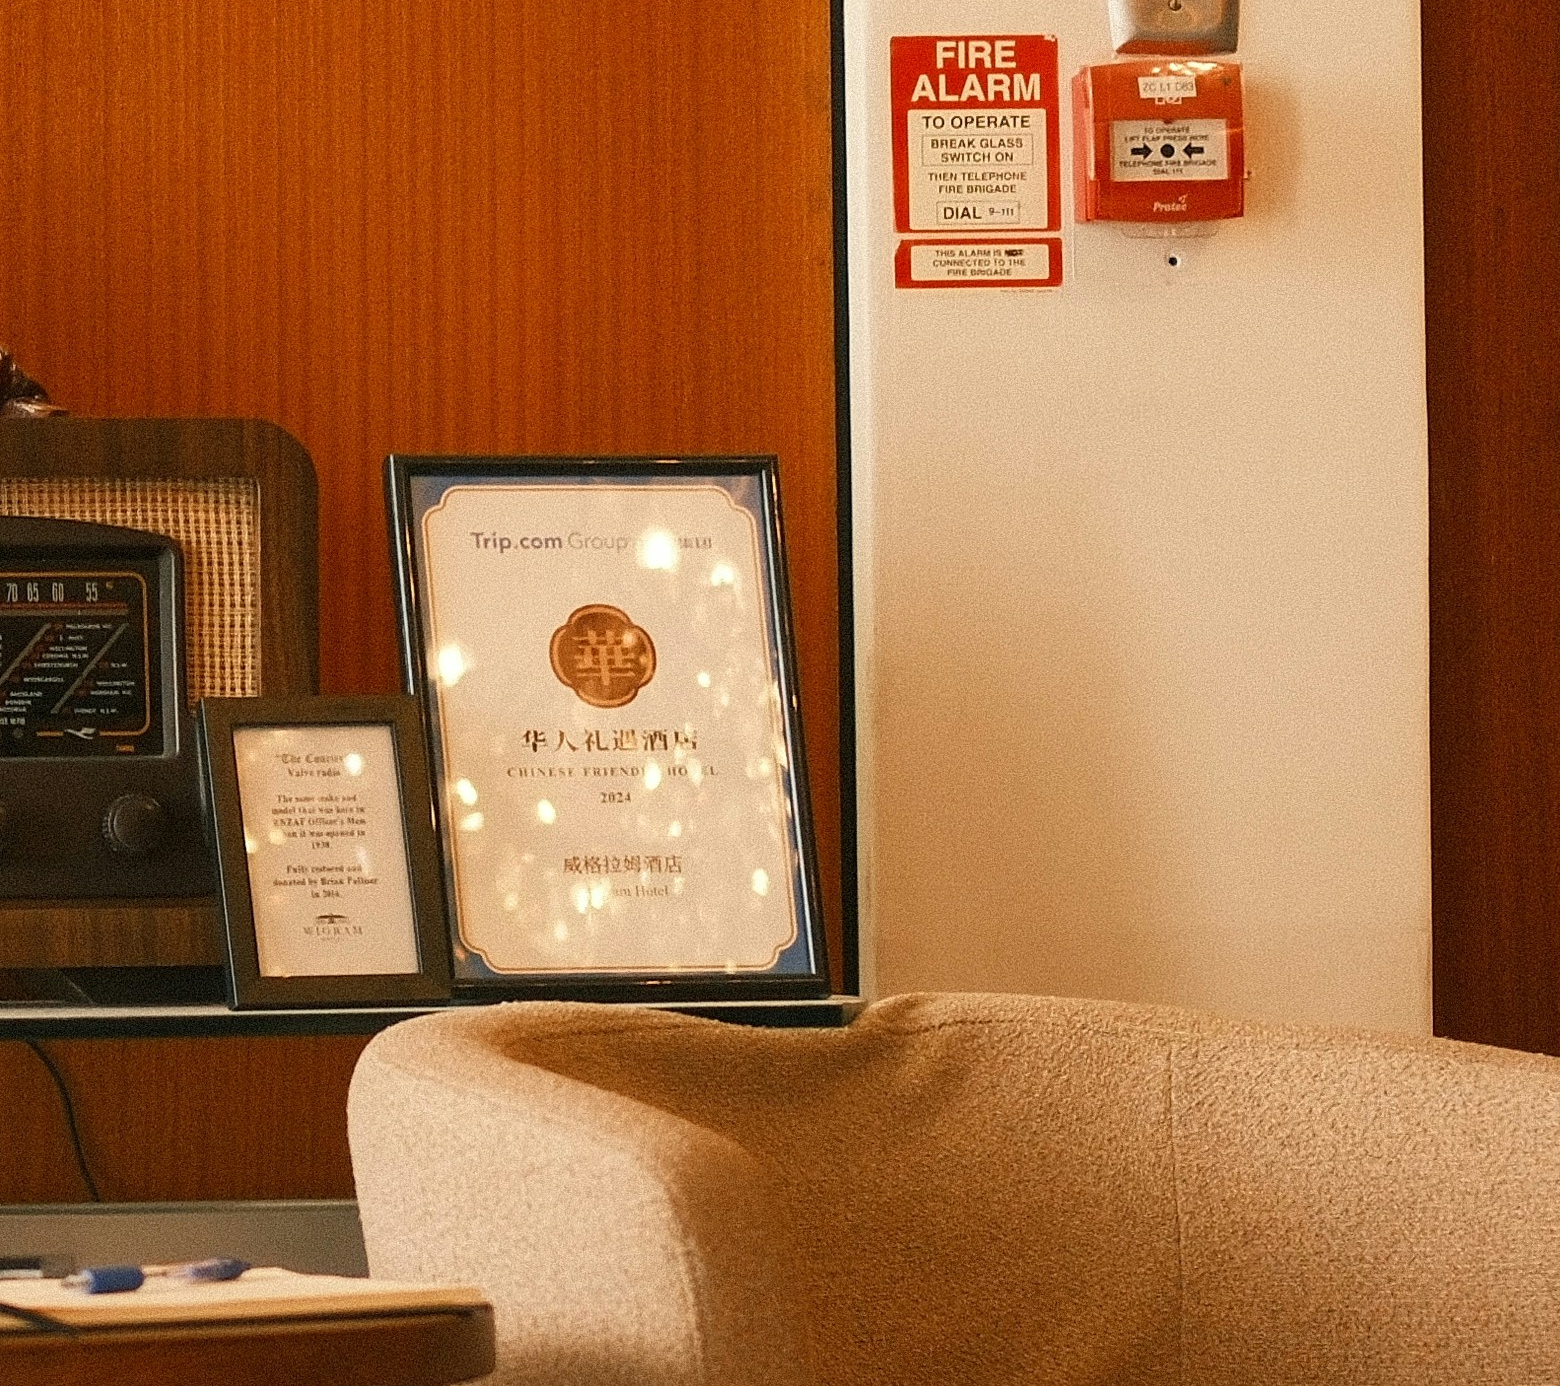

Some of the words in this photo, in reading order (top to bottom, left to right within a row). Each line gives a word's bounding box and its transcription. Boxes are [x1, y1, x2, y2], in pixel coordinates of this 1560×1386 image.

[935, 40, 1017, 69] FIRE
[910, 73, 1041, 102] ALARM
[922, 116, 945, 129] TO
[950, 115, 1031, 129] OPERATE
[931, 138, 976, 149] BREAK
[979, 138, 1024, 149] GLASS
[940, 152, 991, 163] SWITCH
[995, 151, 1014, 162] ON
[1119, 160, 1163, 168] TELEPHONE
[928, 172, 958, 182] THEN
[961, 171, 1027, 181] TELEPHONE
[938, 184, 963, 194] FIRE
[966, 184, 1017, 194] BRIGADE
[943, 206, 983, 220] DIAL
[934, 249, 956, 258] THIS
[958, 249, 992, 257] ALARM
[992, 249, 1002, 257] IS
[932, 259, 991, 268] CONNECTED
[993, 259, 1006, 267] TO
[1008, 259, 1027, 268] THE
[946, 269, 968, 277] FIRE
[970, 268, 1013, 277] BRIGADE
[469, 531, 563, 553] Trip.com
[567, 531, 628, 556] Group
[7, 583, 18, 603] 70
[86, 583, 98, 603] 55
[506, 766, 575, 778] CHINESE
[667, 765, 719, 777] HOEL
[599, 791, 632, 804] 2024
[635, 884, 669, 899] Hotel
